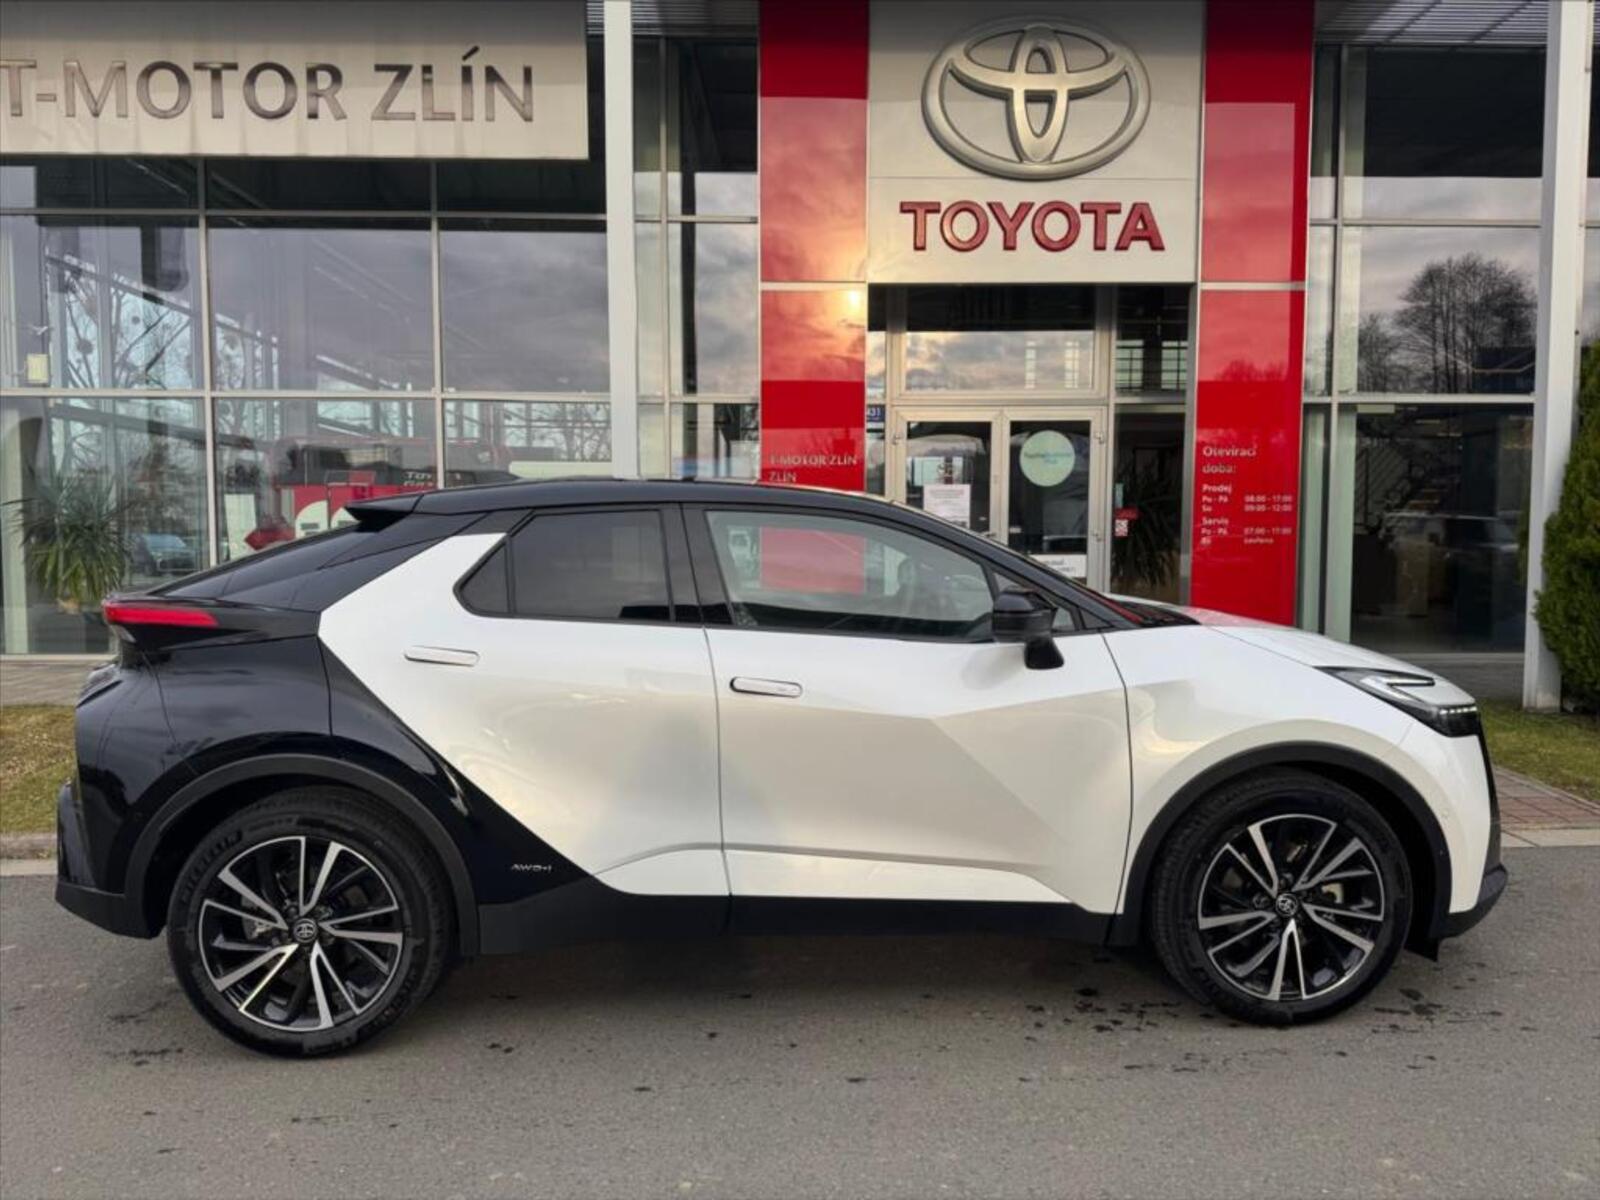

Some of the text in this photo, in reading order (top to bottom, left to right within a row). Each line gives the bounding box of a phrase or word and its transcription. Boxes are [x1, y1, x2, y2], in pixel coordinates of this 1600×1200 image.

[0, 46, 534, 122] T-MOTOR ZLÍN
[899, 200, 1166, 252] TOYOTA
[1202, 484, 1232, 494] Prodej
